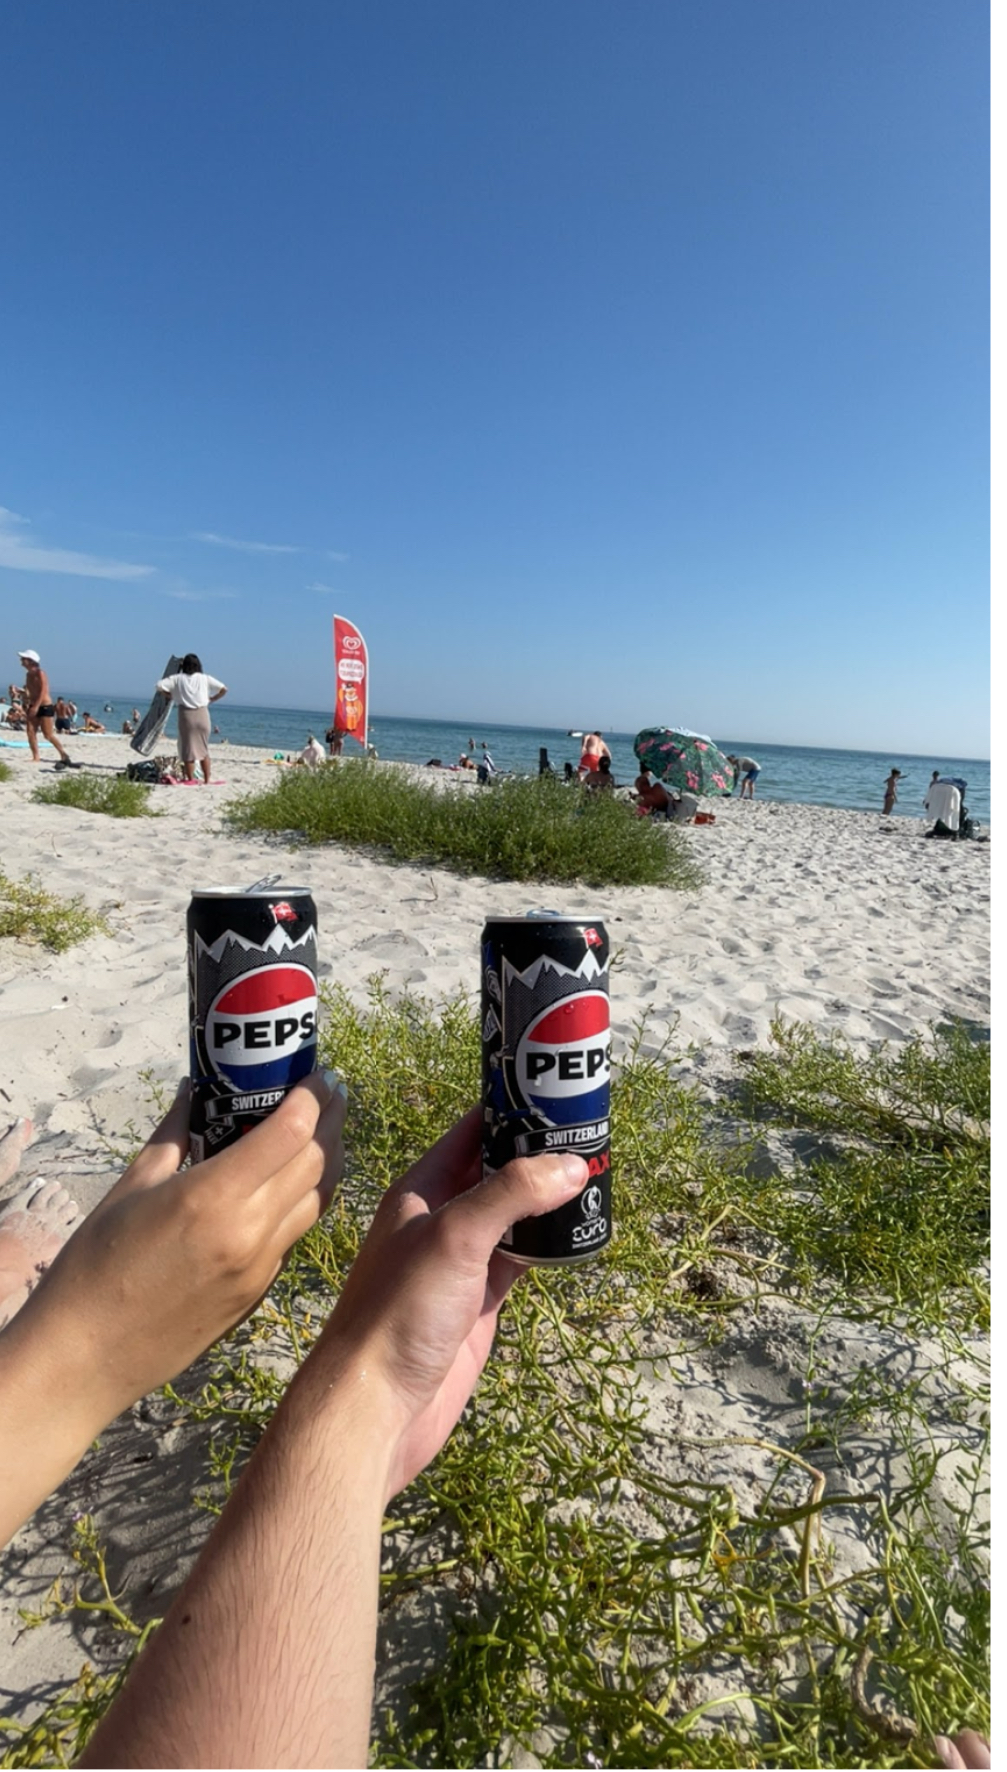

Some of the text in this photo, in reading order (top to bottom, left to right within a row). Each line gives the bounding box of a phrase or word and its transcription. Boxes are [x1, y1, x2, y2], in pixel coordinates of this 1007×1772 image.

[213, 1010, 317, 1049] PEPS
[232, 1090, 285, 1111] SWITZER
[588, 1150, 610, 1178] AX
